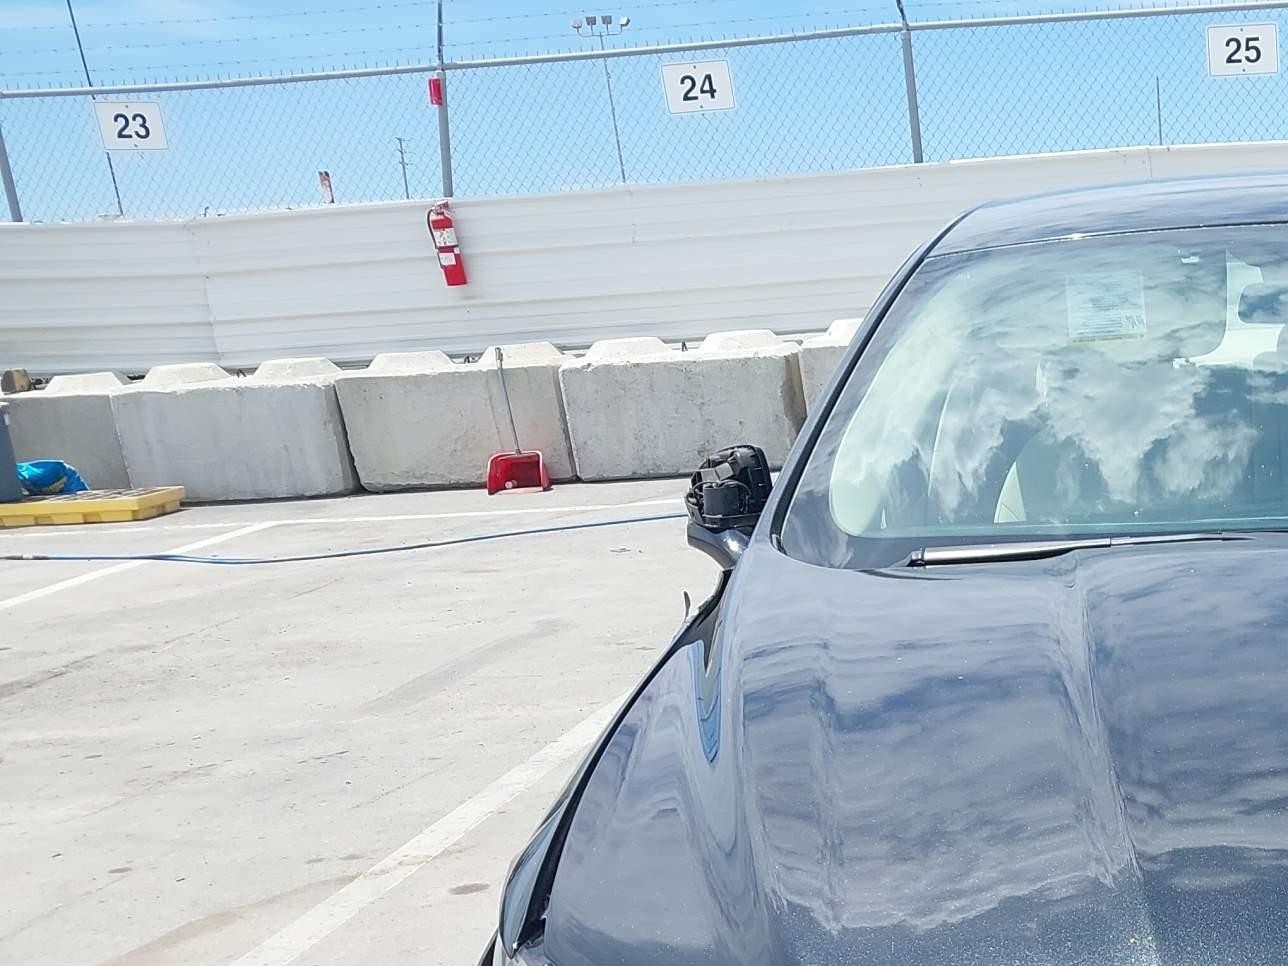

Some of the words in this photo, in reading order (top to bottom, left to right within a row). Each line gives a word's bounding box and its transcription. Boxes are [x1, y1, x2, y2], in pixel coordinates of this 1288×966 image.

[1225, 36, 1262, 64] 25
[680, 73, 717, 102] 24
[113, 113, 150, 139] 23
